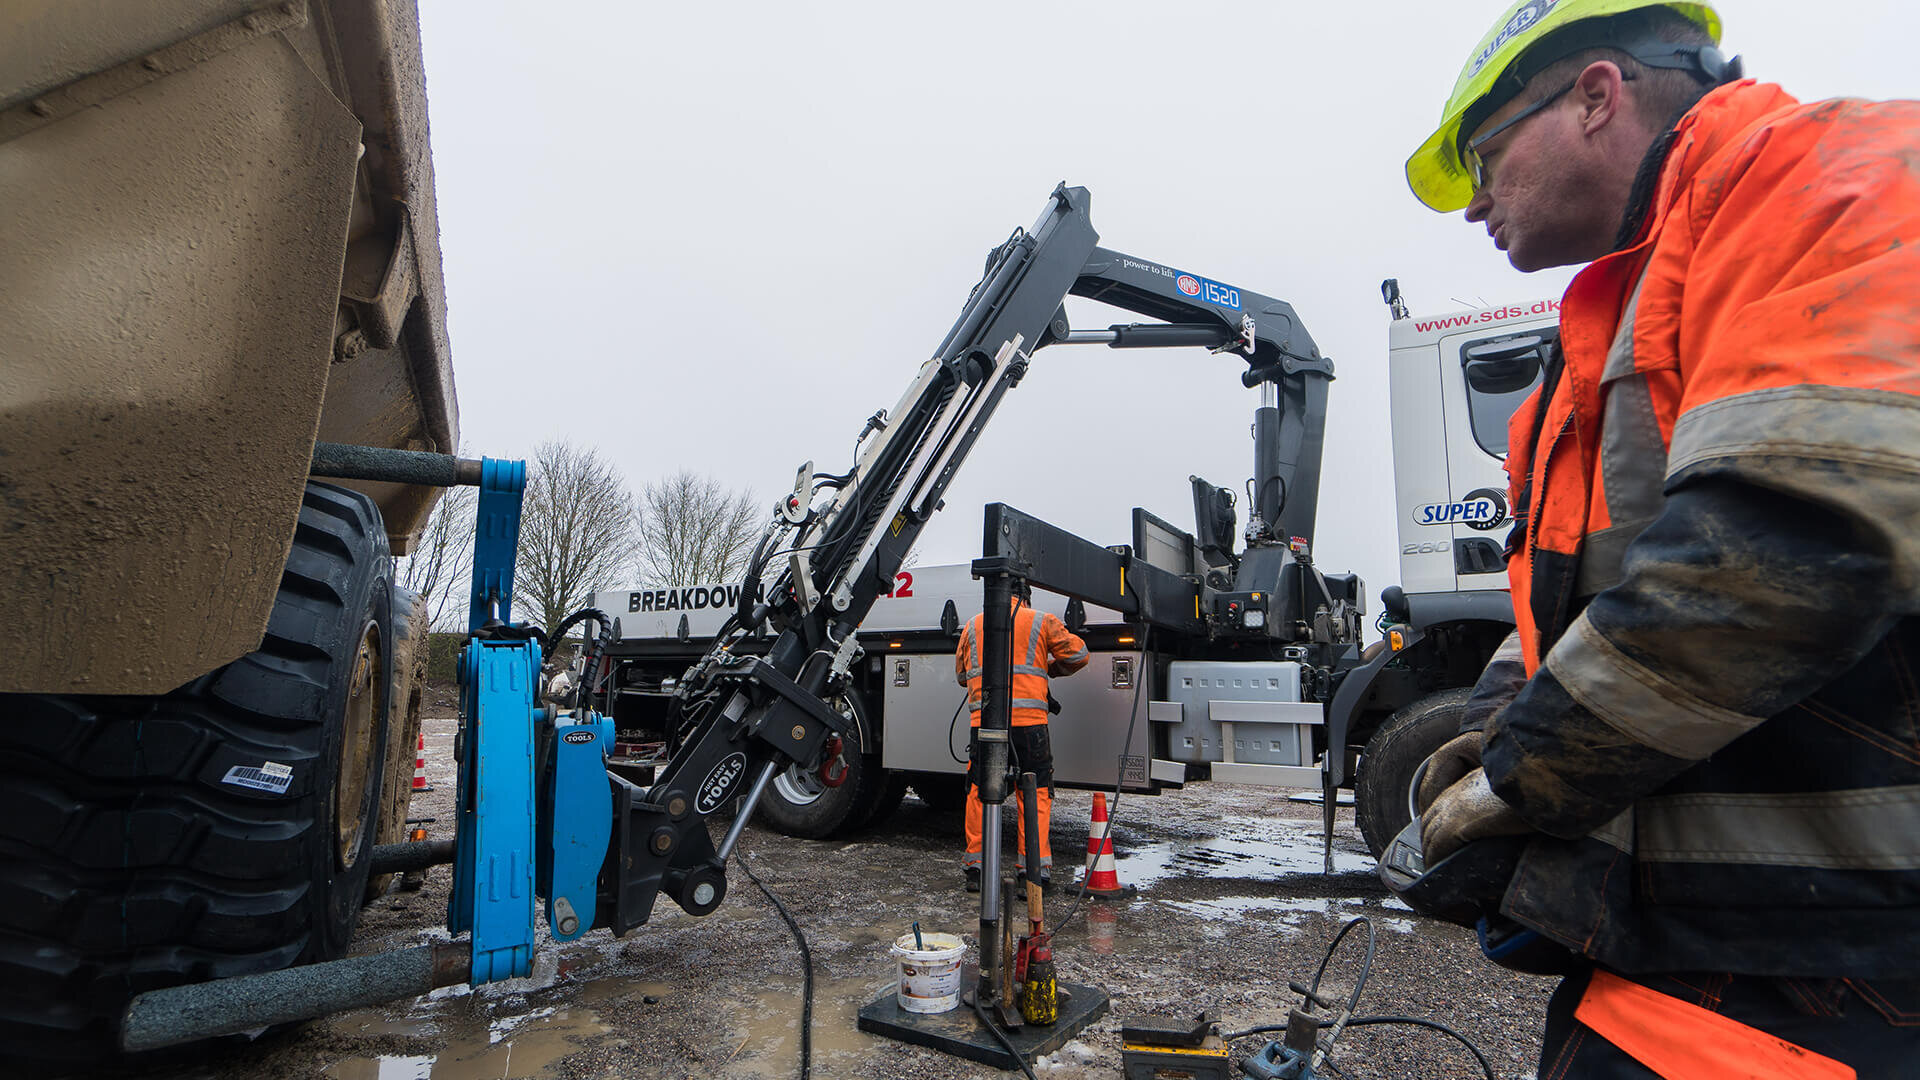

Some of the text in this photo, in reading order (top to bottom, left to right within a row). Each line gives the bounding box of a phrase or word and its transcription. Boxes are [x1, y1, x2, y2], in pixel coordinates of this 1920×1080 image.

[1475, 11, 1530, 70] SUPER
[1123, 259, 1150, 272] power
[1151, 266, 1161, 275] to
[1180, 278, 1198, 293] HMF
[1204, 282, 1240, 308] 1520
[1423, 501, 1490, 523] SUPER
[702, 759, 742, 807] TOOLS
